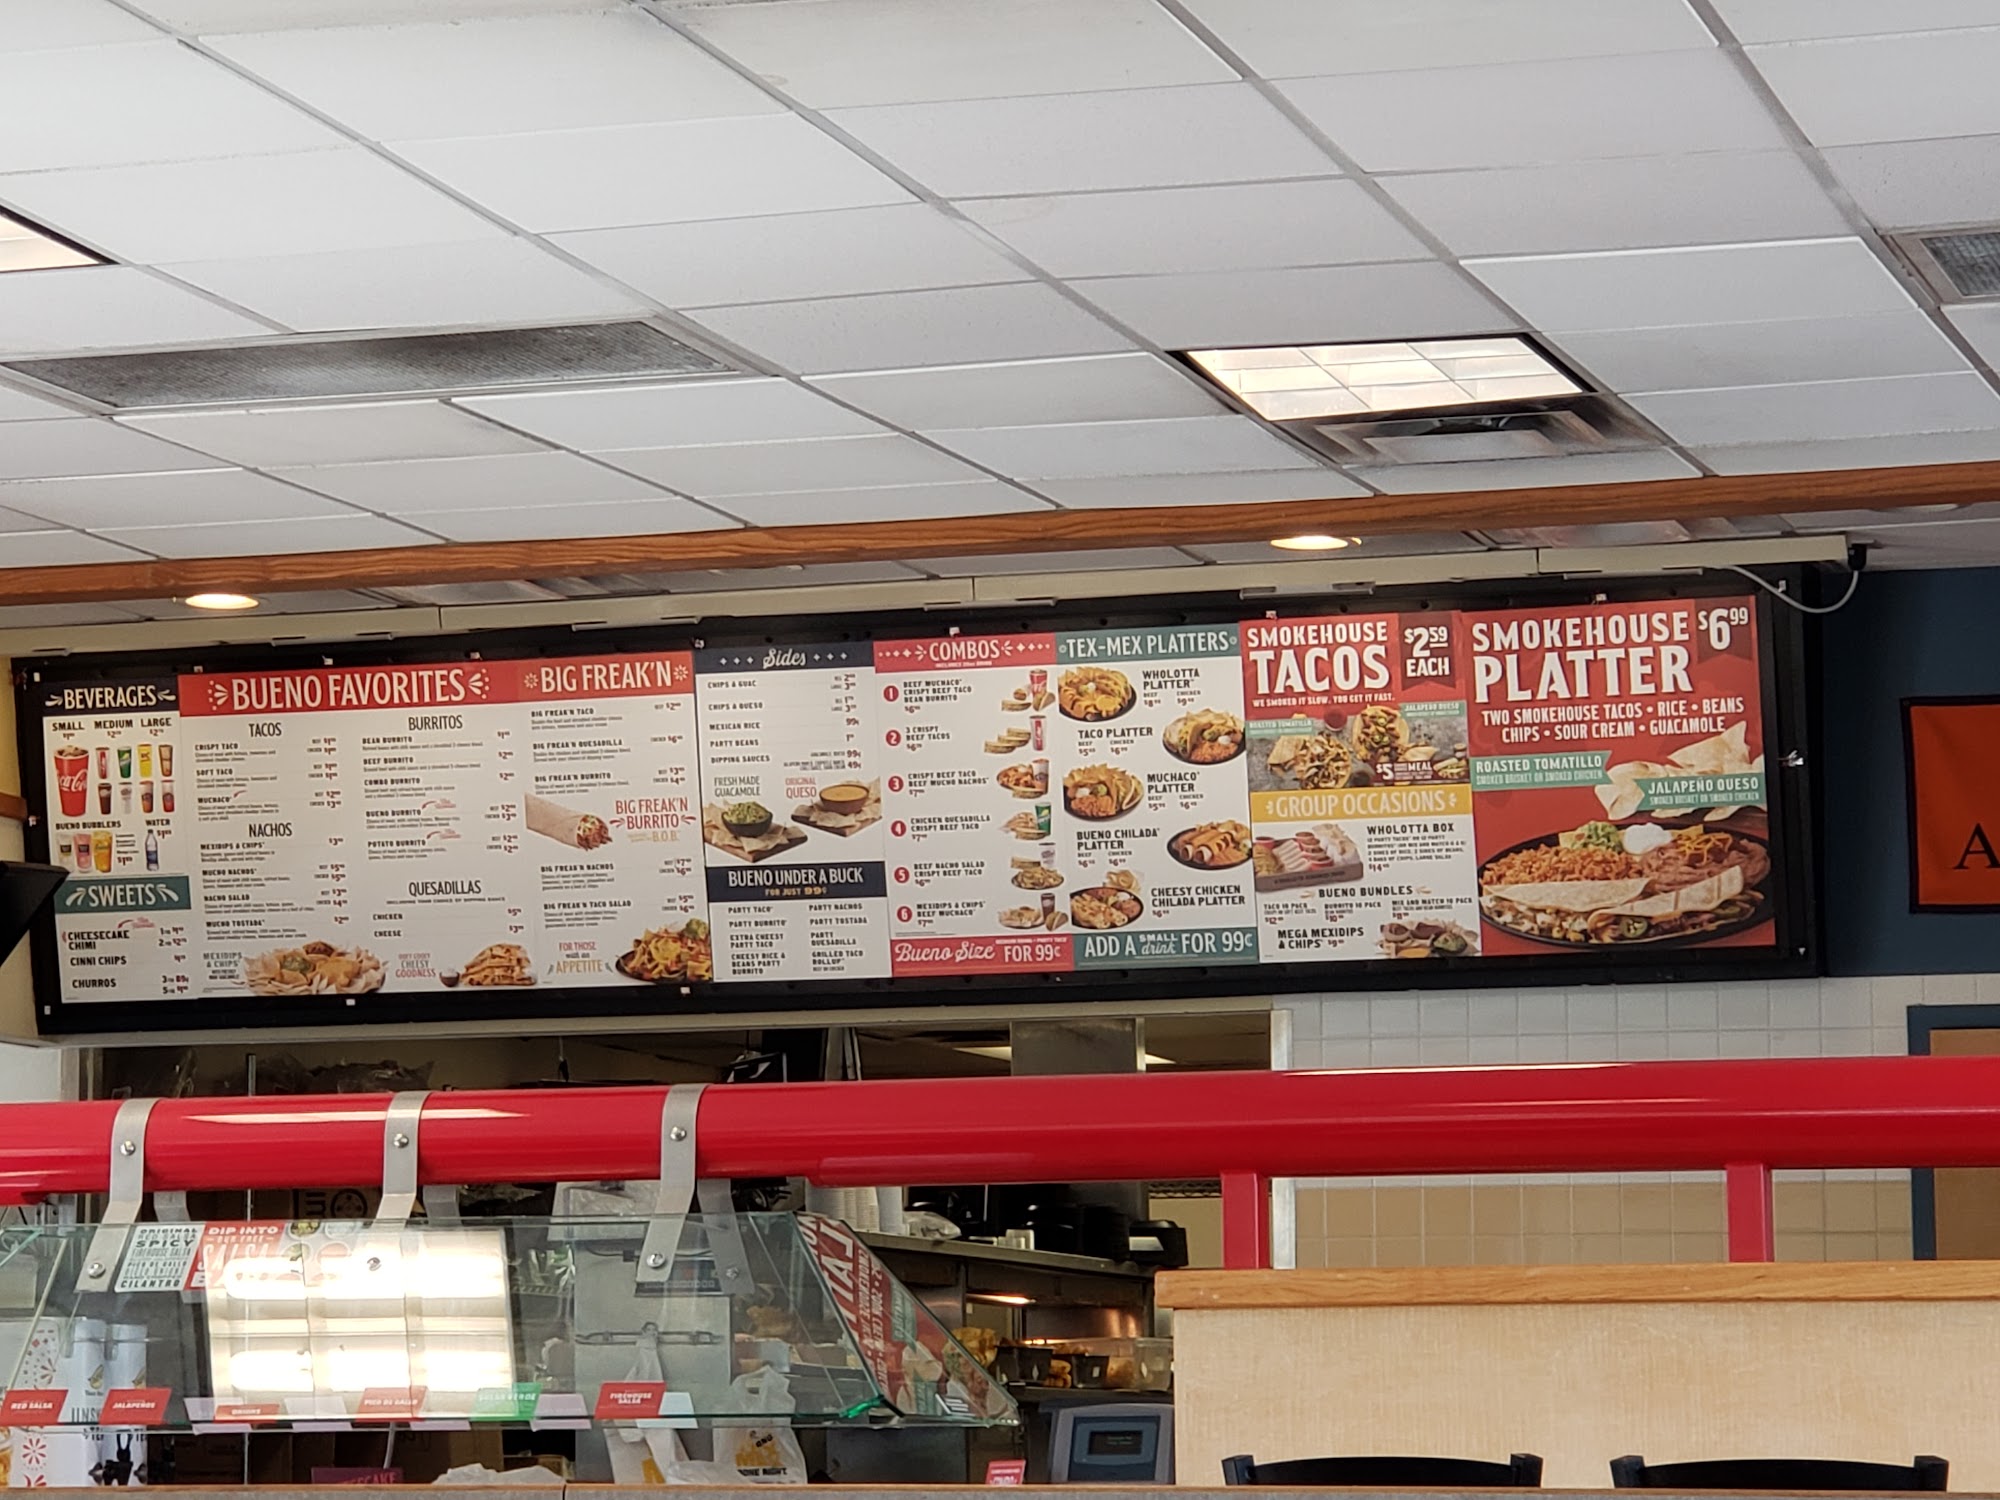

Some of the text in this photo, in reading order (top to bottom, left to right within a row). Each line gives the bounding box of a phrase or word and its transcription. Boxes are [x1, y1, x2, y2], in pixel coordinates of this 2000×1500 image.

[1247, 621, 1388, 647] SMOKEHOUSE
[1472, 611, 1690, 653] SMOKEHOUSE
[1066, 630, 1229, 658] TEX-MEX PLATTERS
[929, 639, 1000, 662] COMBOS
[763, 648, 807, 670] Sides
[1142, 668, 1200, 679] WHOLOTTA
[1248, 644, 1390, 695] TACOS
[1405, 657, 1450, 678] EACH
[541, 661, 672, 693] BIG FREAK'N
[1473, 644, 1693, 704] PLATTER
[231, 668, 466, 711] BUENO FAVORITES
[932, 687, 951, 695] BEEF
[1143, 679, 1190, 691] PLATTER
[63, 685, 157, 710] BEVERAGES
[888, 687, 895, 699] 1
[1252, 699, 1264, 708] WE
[1333, 695, 1348, 704] YOU
[1349, 694, 1363, 703] GET
[1364, 694, 1373, 702] IT
[1374, 693, 1396, 703] FAST.
[1481, 697, 1744, 727] TWO SMOKEHOUSE TACOS RICE BEANS
[52, 722, 85, 732] SMALL
[94, 719, 133, 730] MEDIUM
[141, 717, 172, 728] LARGE
[408, 714, 463, 731] BURRITOS
[709, 722, 760, 731] MEXICAN RICE
[248, 722, 282, 737] TACOS
[1078, 727, 1153, 739] TACO PLATTER
[1501, 716, 1726, 744] CHIPS SOUR CREAM GUACAMOLE
[889, 732, 897, 744] 2
[927, 733, 950, 741] TACOS
[710, 739, 759, 748] PARTY BEANS
[1407, 762, 1432, 771] MEAL
[1476, 755, 1602, 774] ROASTED TOMATILLO
[1375, 763, 1394, 780] $5
[714, 776, 760, 786] FRESH MADE
[785, 777, 817, 786] ORIGINAL
[892, 778, 900, 790] 3
[1147, 773, 1197, 783] MUCHACO
[1717, 776, 1759, 791] QUESO
[714, 786, 761, 798] GUACAMOLE
[786, 787, 817, 799] QUESO
[1148, 783, 1195, 794] PLATTER
[615, 797, 688, 814] BIG FREAK'N
[1275, 790, 1445, 818] GROUP OCCASIONS
[627, 814, 680, 830] BURRITO
[895, 822, 902, 834] 4
[249, 822, 292, 838] NACHOS
[1076, 829, 1157, 840] BUENO CHILADA
[1367, 823, 1455, 836] WHOLOTTA BOX
[1077, 840, 1124, 851] PLATTER
[728, 867, 864, 887] BUENO UNDER A BUCK
[898, 869, 905, 882] 5
[965, 868, 982, 876] TACO
[408, 880, 482, 897] QUESADILLAS
[765, 888, 780, 897] FOR
[782, 887, 801, 896] JUST
[1151, 885, 1241, 897] CHEESY CHICKEN
[1318, 885, 1414, 898] BUENO BUNDLES
[88, 883, 156, 907] SWEETS
[1152, 895, 1245, 908] CHILADA PLATTER
[901, 908, 908, 920] 6
[68, 930, 130, 941] CHEESECAKE
[810, 931, 833, 939] PARTY
[1139, 933, 1178, 942] SMALL
[1277, 926, 1364, 939] MEGA MEXIDIPS
[68, 942, 96, 950] CHIMI
[558, 941, 572, 951] FOR
[730, 940, 773, 949] PARTY TACO
[1084, 935, 1120, 957] ADD
[1125, 935, 1136, 956] A
[1141, 941, 1177, 955] drink
[1181, 933, 1217, 954] FOR
[1288, 939, 1321, 949] CHIPS
[895, 943, 954, 962] Bueno
[954, 940, 995, 963] Size
[1004, 945, 1033, 963] FOR
[70, 956, 127, 966] CINNI CHIPS
[556, 959, 604, 974] APPETITE
[395, 969, 436, 978] GOODNESS
[72, 979, 116, 988] CHURROS
[208, 1225, 279, 1235] DIP INTO
[135, 1239, 194, 1248] SPICY
[120, 1279, 180, 1288] CILANTRO
